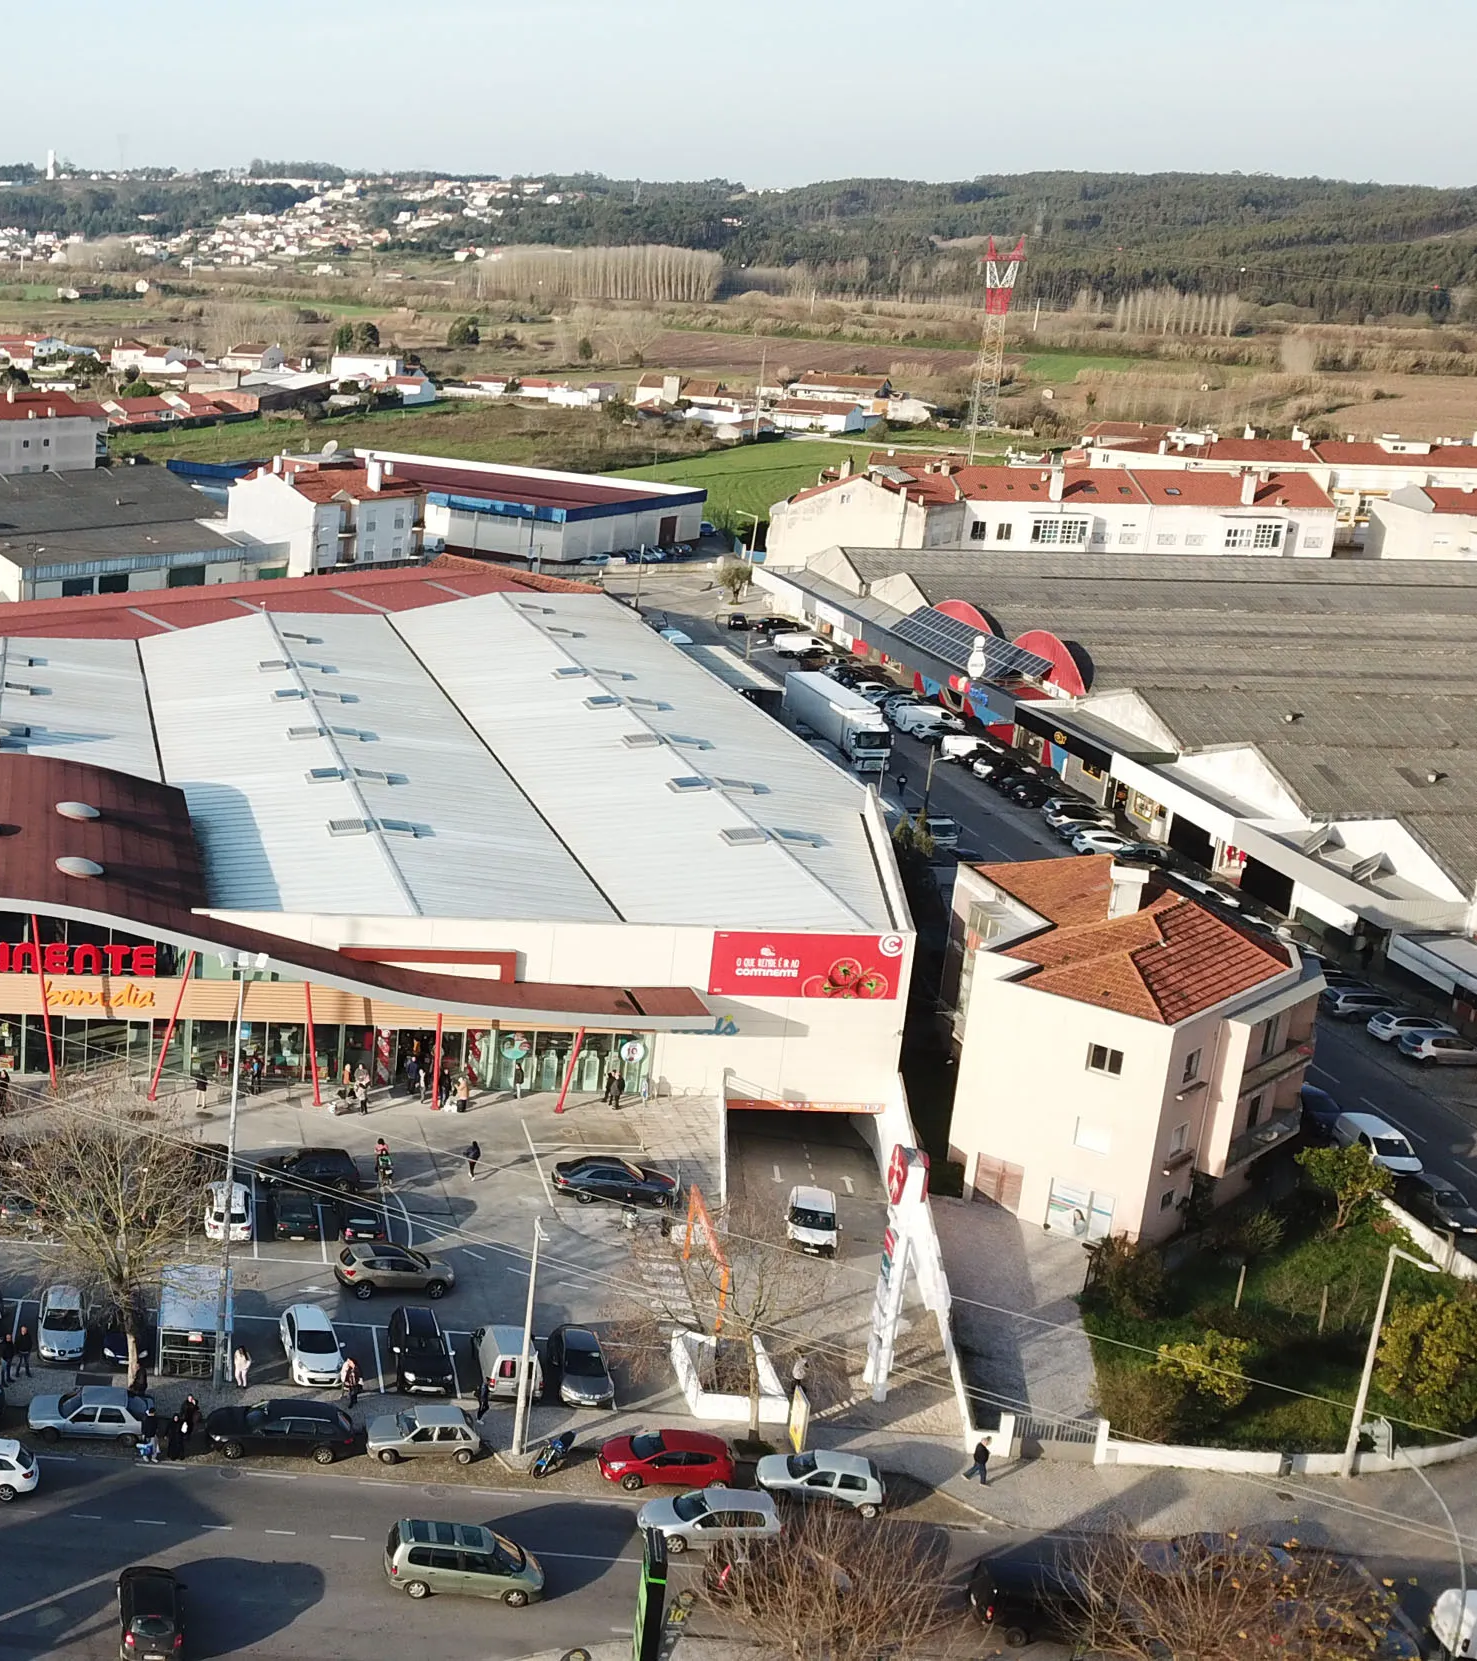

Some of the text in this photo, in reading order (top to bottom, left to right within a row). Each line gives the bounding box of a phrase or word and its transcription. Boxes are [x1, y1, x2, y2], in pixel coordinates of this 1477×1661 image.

[743, 957, 755, 967] QUE
[735, 968, 799, 977] CONTINENTE
[44, 980, 157, 1008] bom dia
